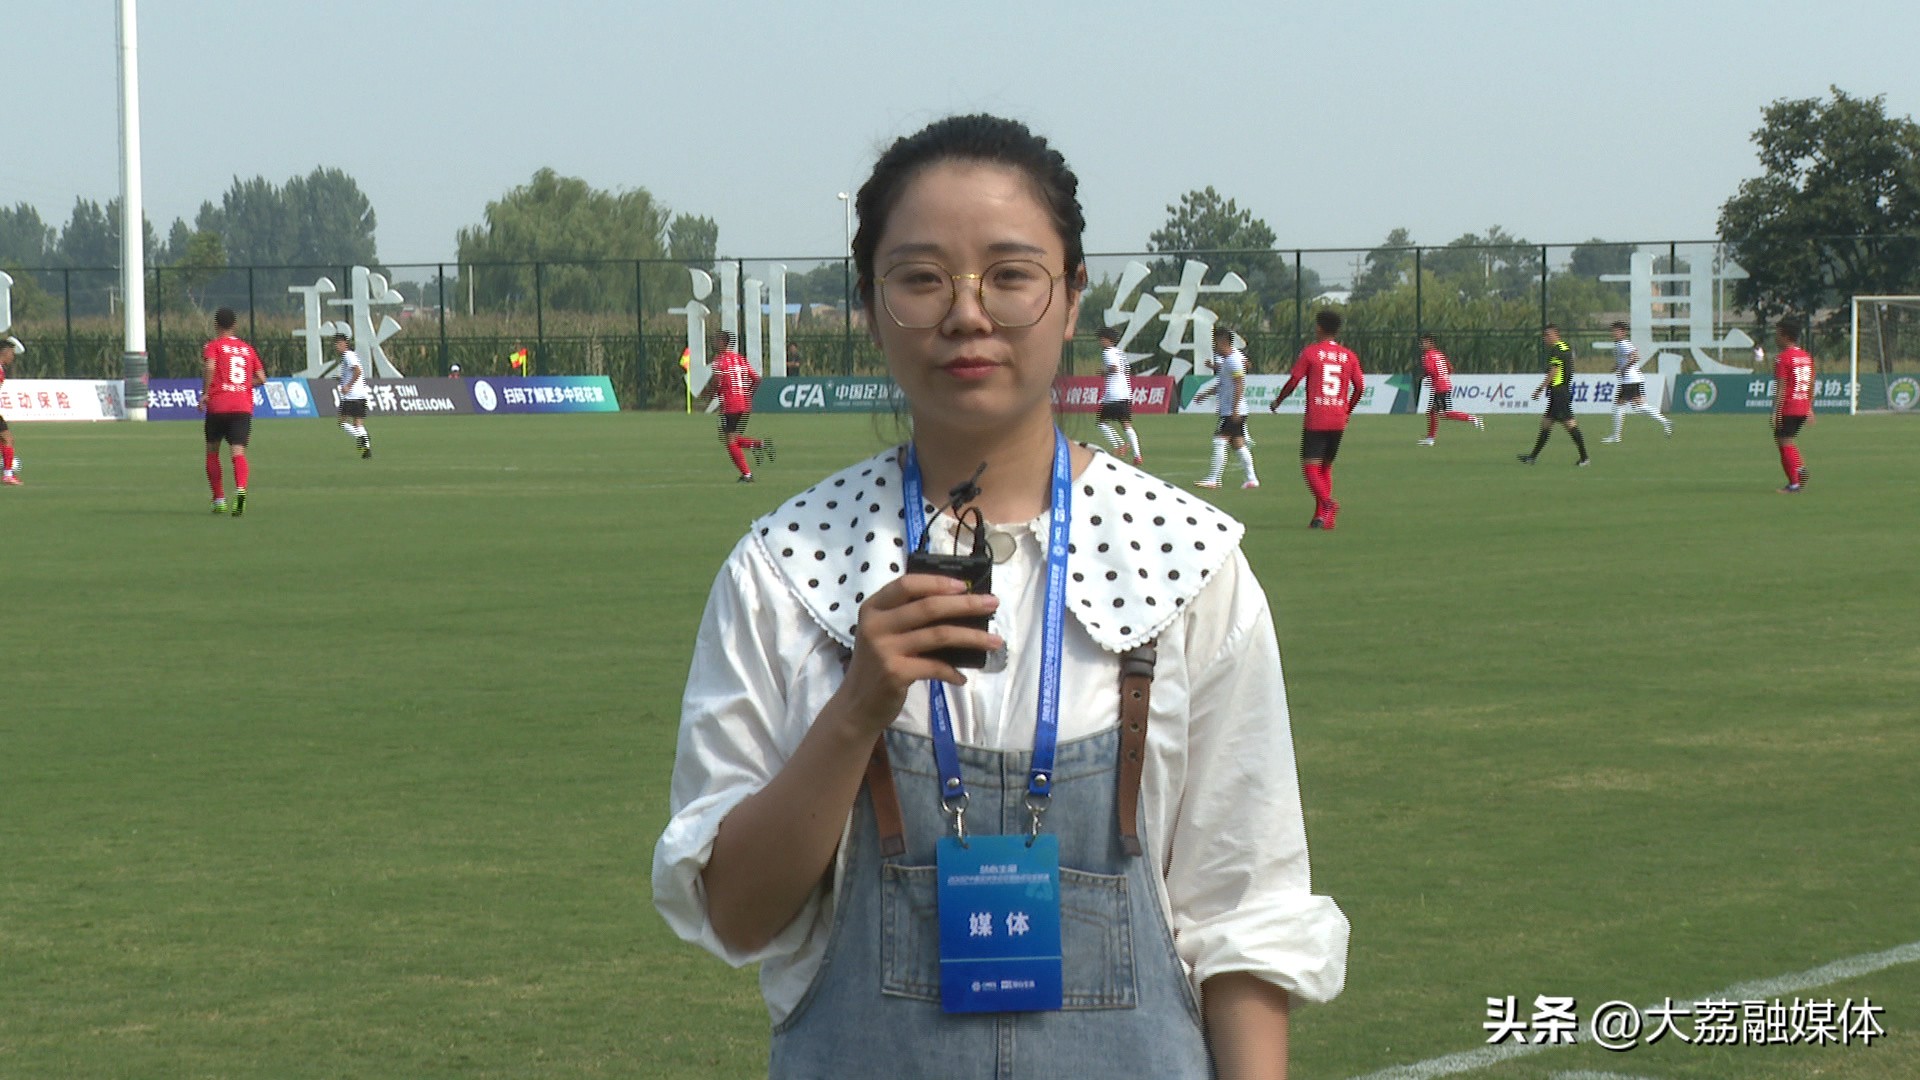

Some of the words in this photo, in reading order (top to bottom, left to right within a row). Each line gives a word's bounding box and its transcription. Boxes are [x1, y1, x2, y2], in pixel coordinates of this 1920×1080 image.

[231, 356, 248, 384] 6
[1322, 364, 1342, 395] 5
[0, 392, 71, 408] 运动保险
[779, 384, 825, 408] CFA
[1450, 383, 1515, 402] INO-LAC
[969, 912, 1030, 937] 媒体
